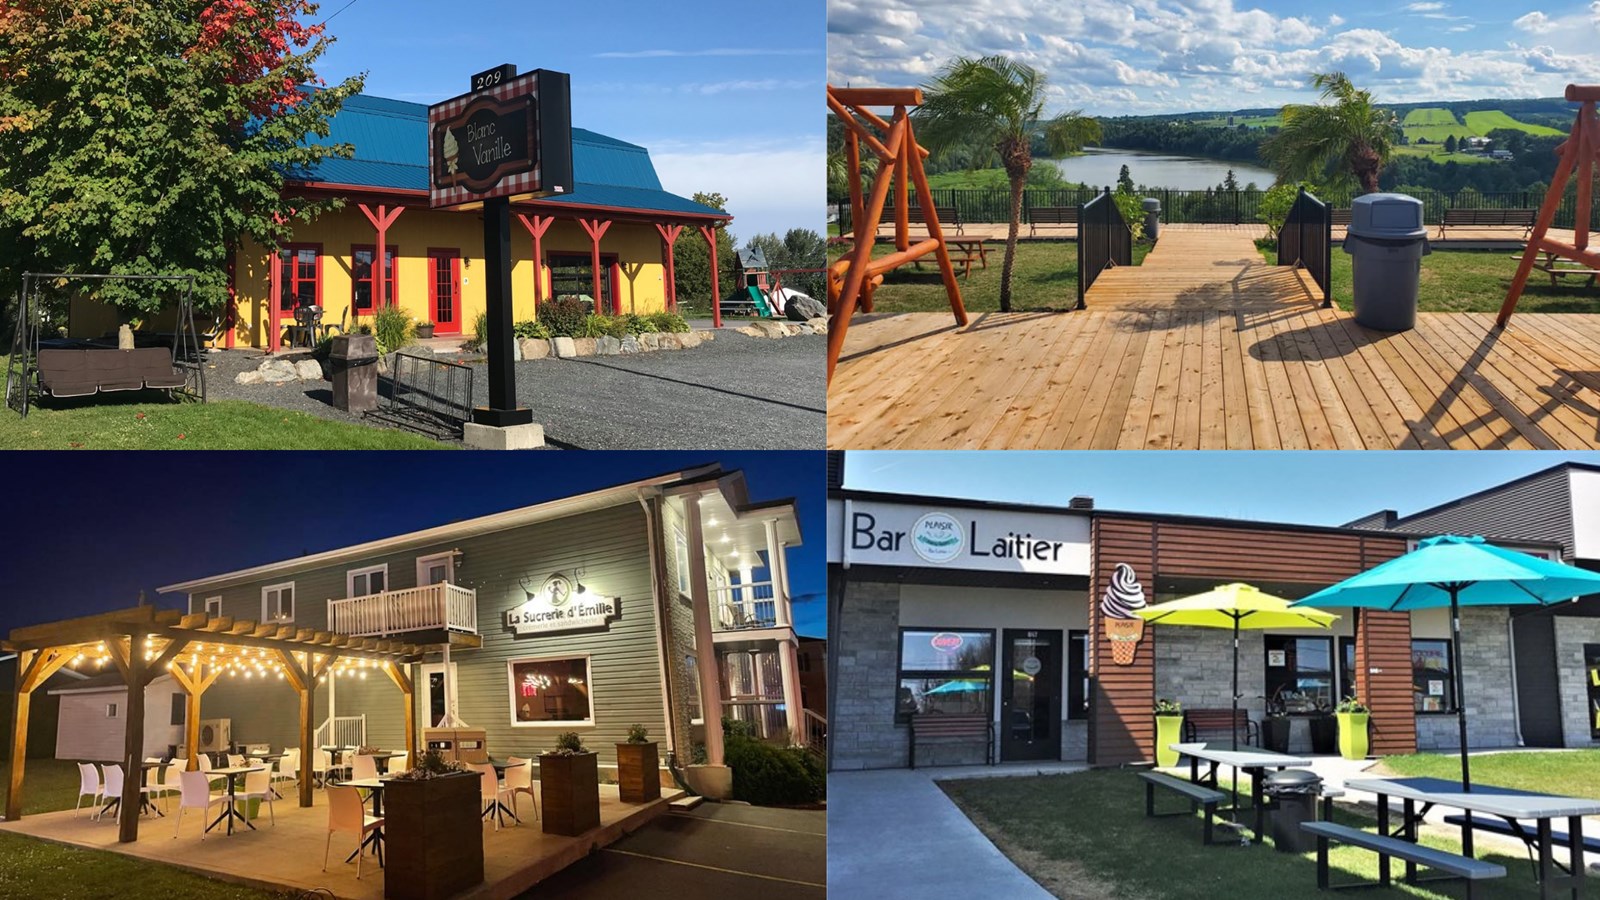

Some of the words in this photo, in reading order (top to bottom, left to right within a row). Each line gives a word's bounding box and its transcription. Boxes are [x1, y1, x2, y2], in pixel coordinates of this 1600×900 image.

[477, 70, 502, 90] 209
[466, 121, 496, 143] Blanc
[472, 136, 512, 165] Vanille
[851, 512, 906, 552] Bar
[970, 520, 1063, 562] Laitier
[508, 613, 521, 625] La
[523, 608, 564, 623] Sucrerie
